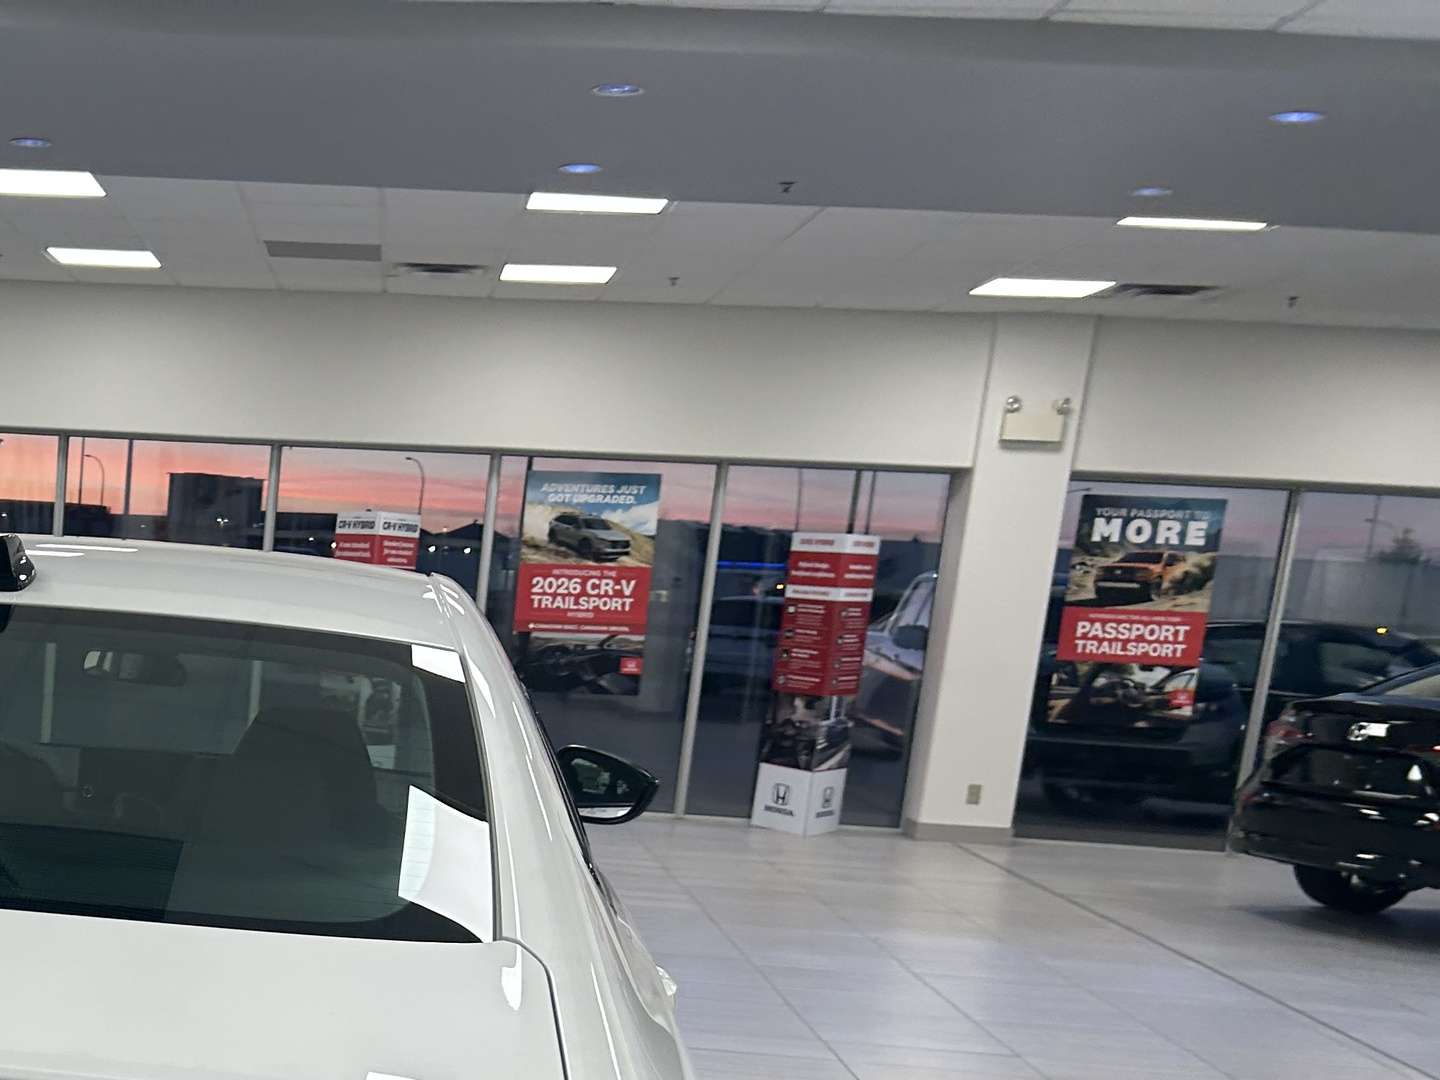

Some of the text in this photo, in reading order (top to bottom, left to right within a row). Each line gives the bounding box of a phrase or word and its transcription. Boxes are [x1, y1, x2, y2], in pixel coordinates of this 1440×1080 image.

[548, 493, 570, 503] GOT
[616, 484, 647, 496] JUST
[1095, 507, 1128, 518] YOUR
[1130, 508, 1191, 520] PASSPORT
[1091, 517, 1208, 546] MORE
[530, 576, 637, 596] 2026 CR-V
[530, 594, 635, 612] TRAILSPORT
[1075, 620, 1192, 643] PASSPORT
[1074, 639, 1188, 658] TRAILSPORT
